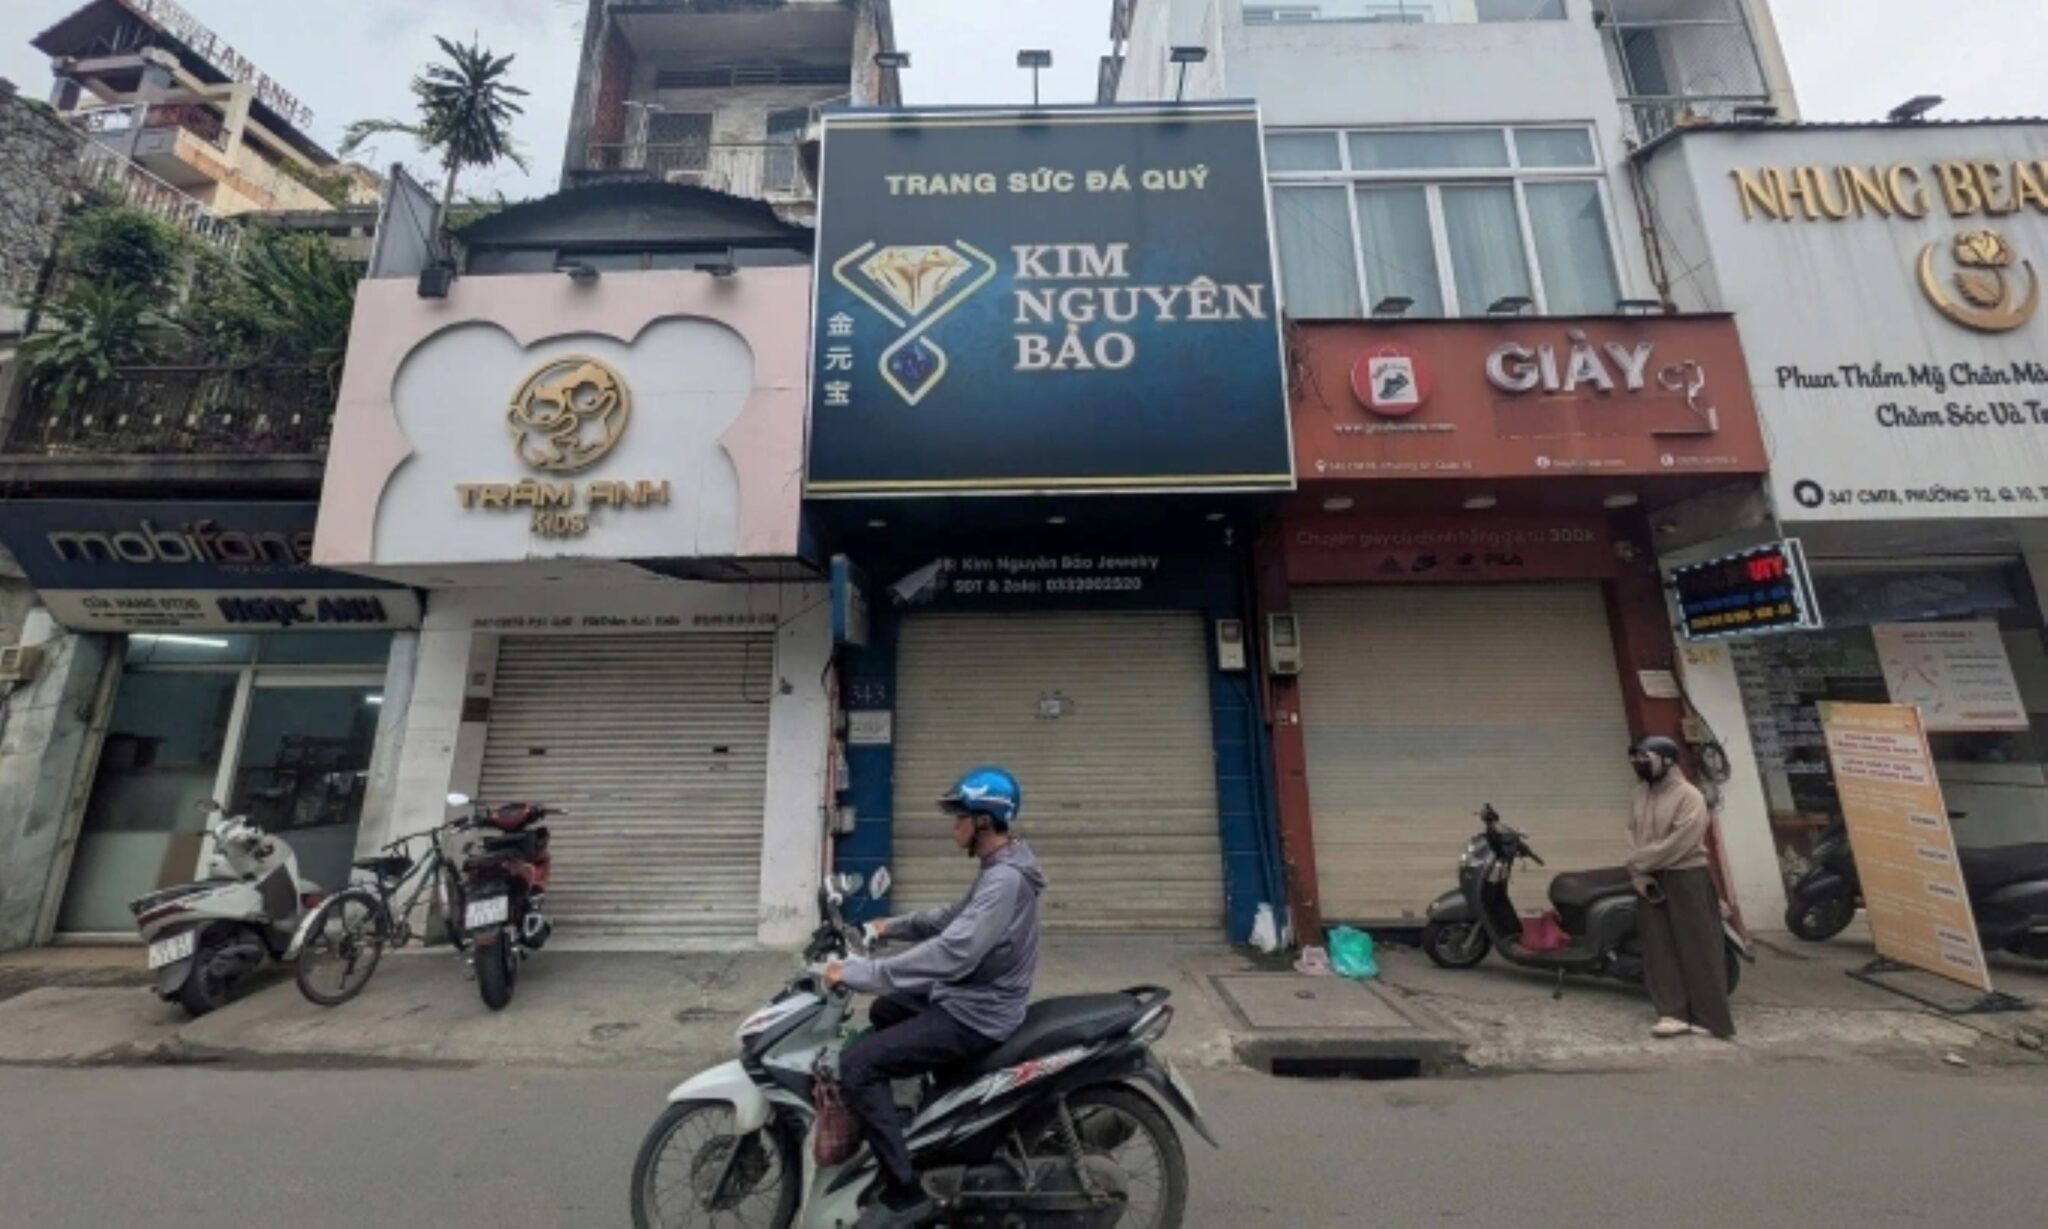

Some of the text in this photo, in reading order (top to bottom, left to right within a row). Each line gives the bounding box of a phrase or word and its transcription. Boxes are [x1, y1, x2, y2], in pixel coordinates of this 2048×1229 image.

[885, 164, 1211, 196] TRANG SỨC ĐÁ QUÝ
[1730, 160, 2048, 221] NHUNG BEA
[1012, 242, 1130, 279] KIM
[1014, 275, 1267, 323] NGUYÊN
[1014, 323, 1136, 371] BẢO
[1485, 329, 1654, 392] GIÀY
[1775, 364, 1838, 389] Phun
[1838, 360, 1906, 388] Thẩm
[1908, 363, 1946, 394] Mỹ
[1950, 362, 2011, 386] Chân
[1875, 402, 1944, 428] Chăm
[1945, 402, 1990, 425] Sóc
[1989, 402, 2026, 425] Và
[454, 477, 672, 511] TRÂM ANH
[961, 556, 993, 571] Kim
[996, 555, 1058, 574] Nguyên
[1061, 553, 1093, 570] Bảo
[987, 579, 1000, 593] &
[317, 595, 390, 624] ANH
